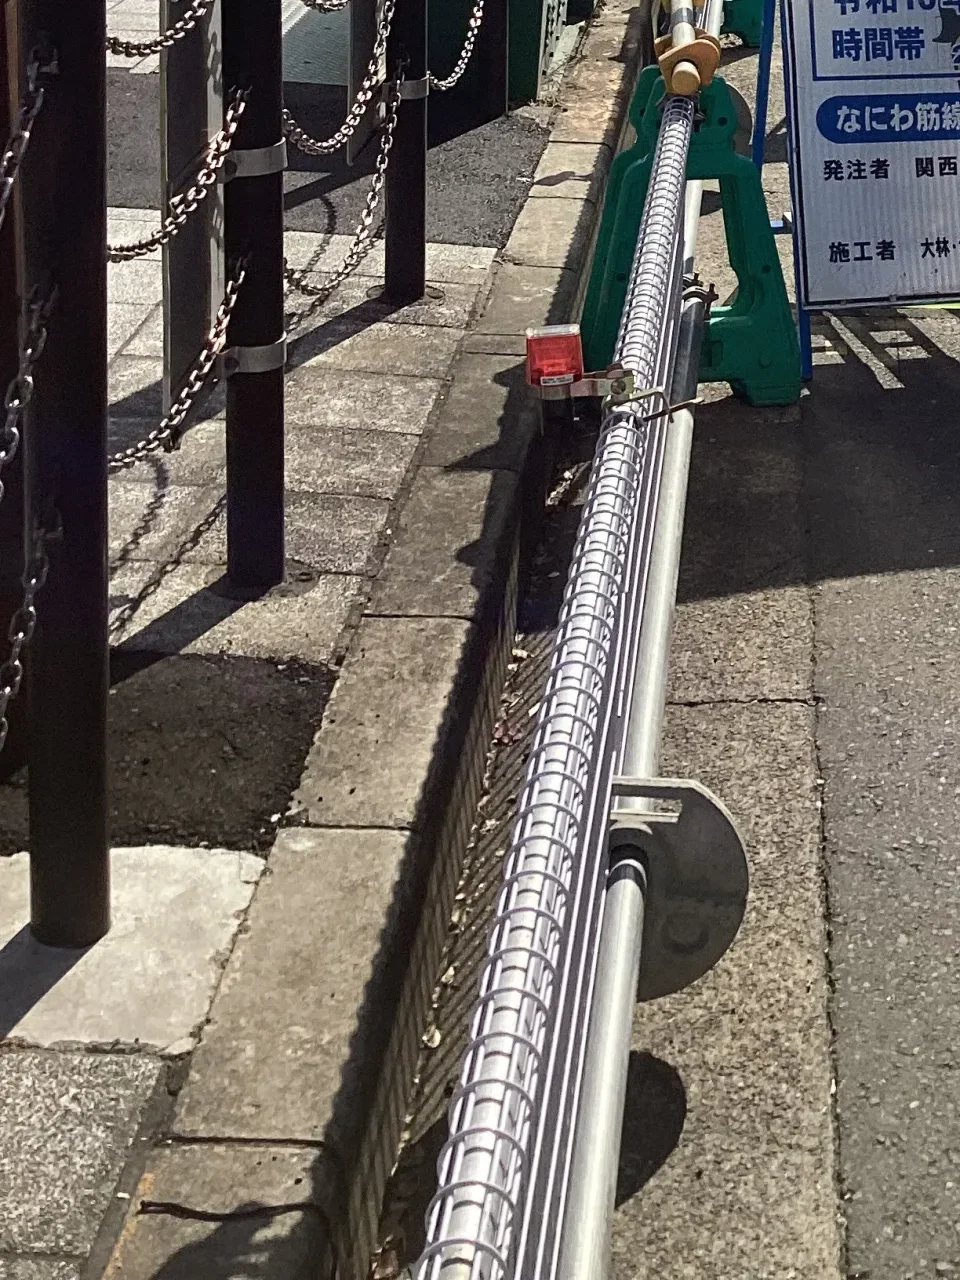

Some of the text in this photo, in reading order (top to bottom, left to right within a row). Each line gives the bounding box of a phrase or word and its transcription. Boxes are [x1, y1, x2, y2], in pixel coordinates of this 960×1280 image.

[832, 26, 926, 62] 時間帯
[823, 157, 890, 181] 発注者
[829, 239, 896, 263] 施工者
